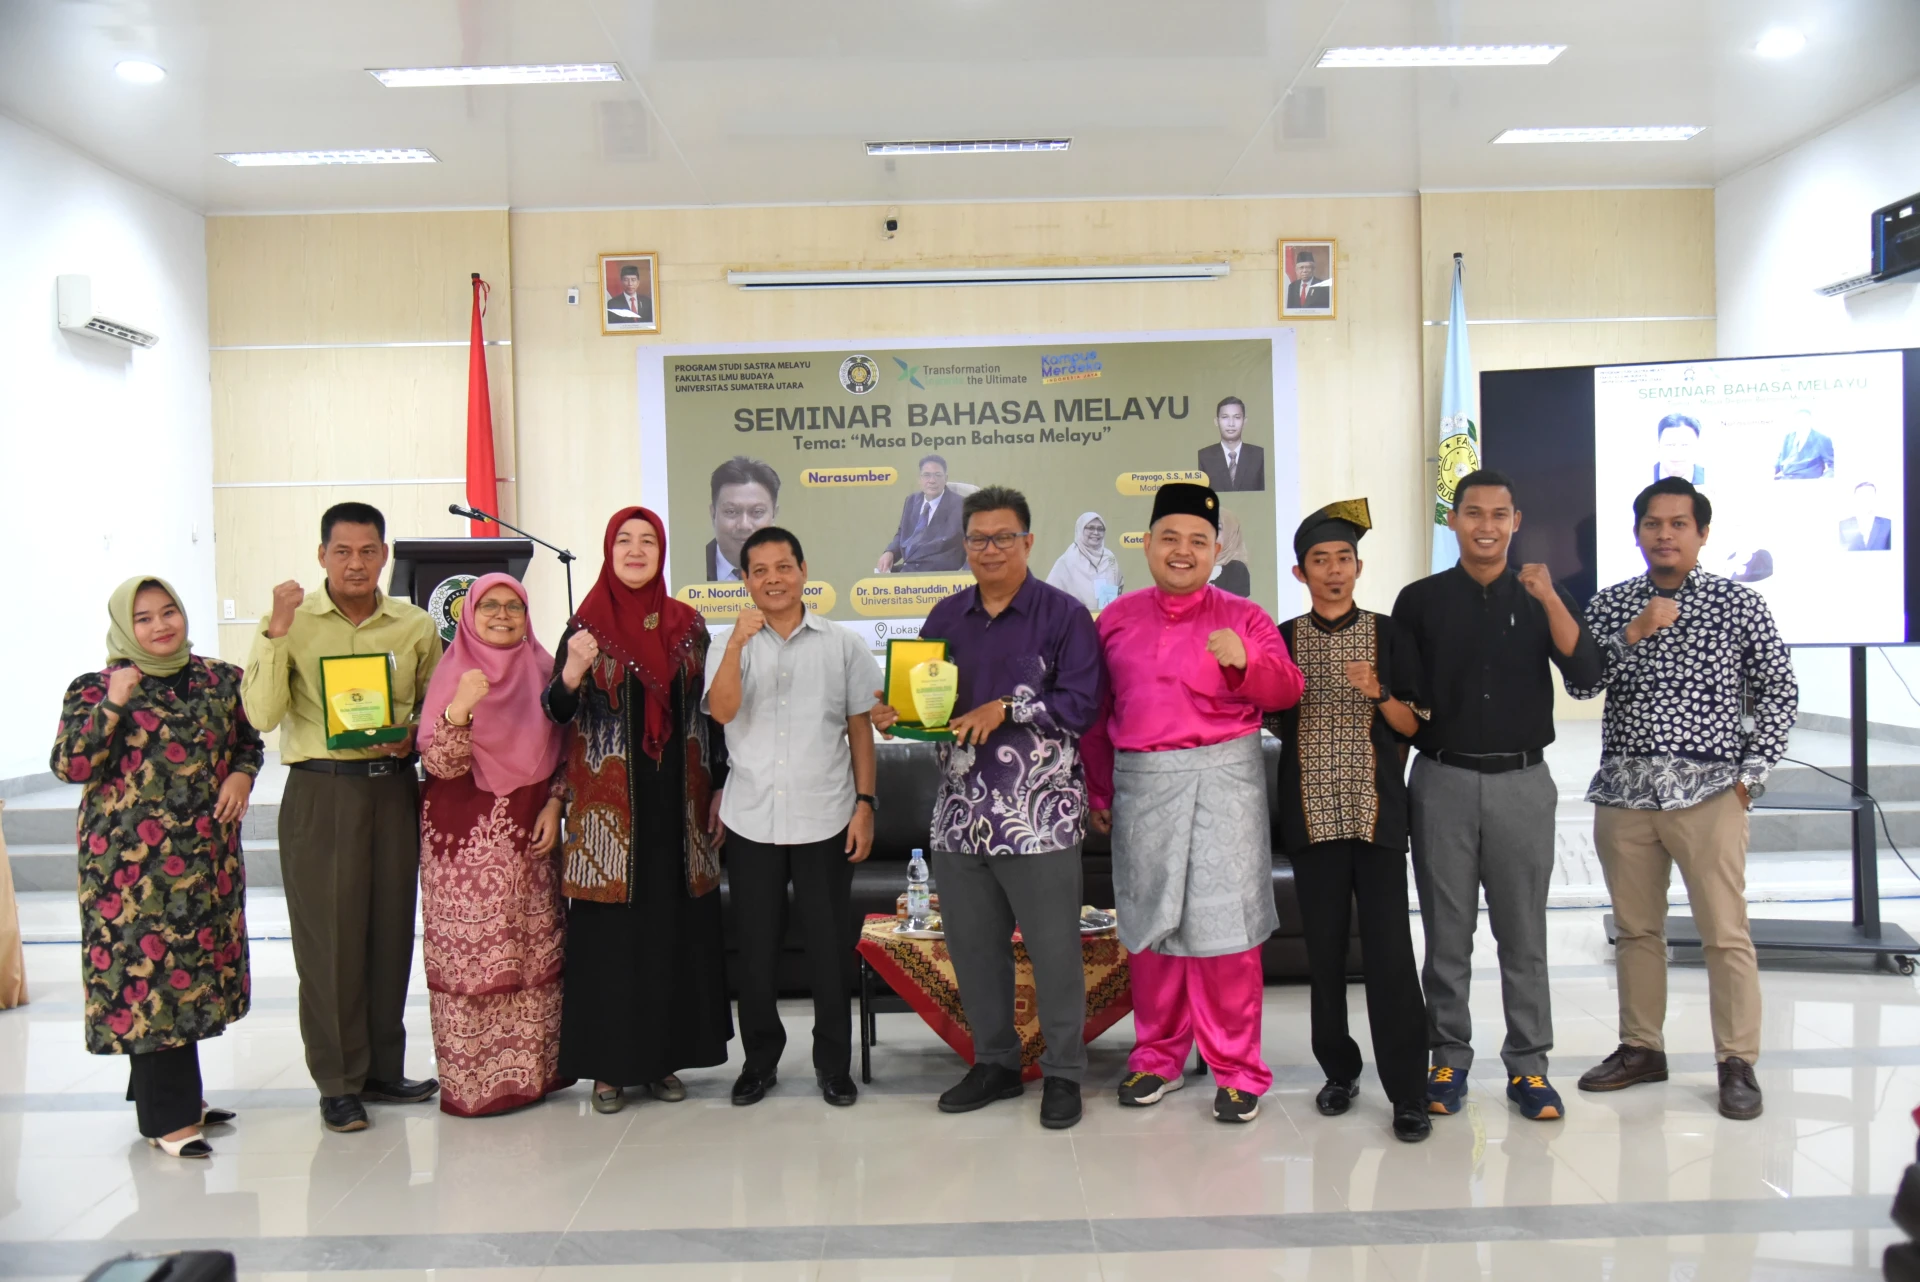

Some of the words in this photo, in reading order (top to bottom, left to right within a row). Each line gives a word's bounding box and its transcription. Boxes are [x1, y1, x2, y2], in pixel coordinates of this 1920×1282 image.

[1042, 351, 1097, 366] Kampus
[674, 364, 717, 372] PROGRAM
[718, 363, 742, 371] STUDI
[744, 362, 776, 370] SASTRA
[777, 361, 811, 369] MELAYU
[923, 363, 1001, 375] Transformation
[1042, 361, 1103, 377] Merdeka
[674, 374, 717, 382] FAKULTAS
[718, 373, 739, 381] ILMU
[740, 372, 774, 380] BUDAYA
[967, 375, 983, 385] the
[986, 374, 1027, 384] Ultimate
[675, 384, 729, 393] UNIVERSITAS
[730, 382, 775, 391] SUMATERA
[776, 381, 804, 390] UTARA
[1638, 384, 1716, 399] SEMINAR
[1723, 381, 1793, 395] BAHASA
[1797, 377, 1868, 391] MELAYU
[734, 404, 892, 432] SEMINAR
[908, 400, 1046, 427] BAHASA
[1054, 395, 1189, 422] MELAYU
[793, 435, 846, 450] Tema:
[911, 432, 966, 450] Depan
[971, 429, 1035, 445] Bahasa
[808, 470, 891, 483] Narasumber
[1131, 473, 1165, 482] Prayogo,
[1184, 472, 1202, 480] M.Si
[688, 588, 705, 599] Dr.
[708, 587, 749, 598] Noordi
[856, 587, 870, 596] Dr.
[872, 587, 891, 596] Drs.
[894, 585, 951, 595] Baharuddin,
[861, 596, 914, 606] Universitas
[696, 603, 741, 613] Universiti
